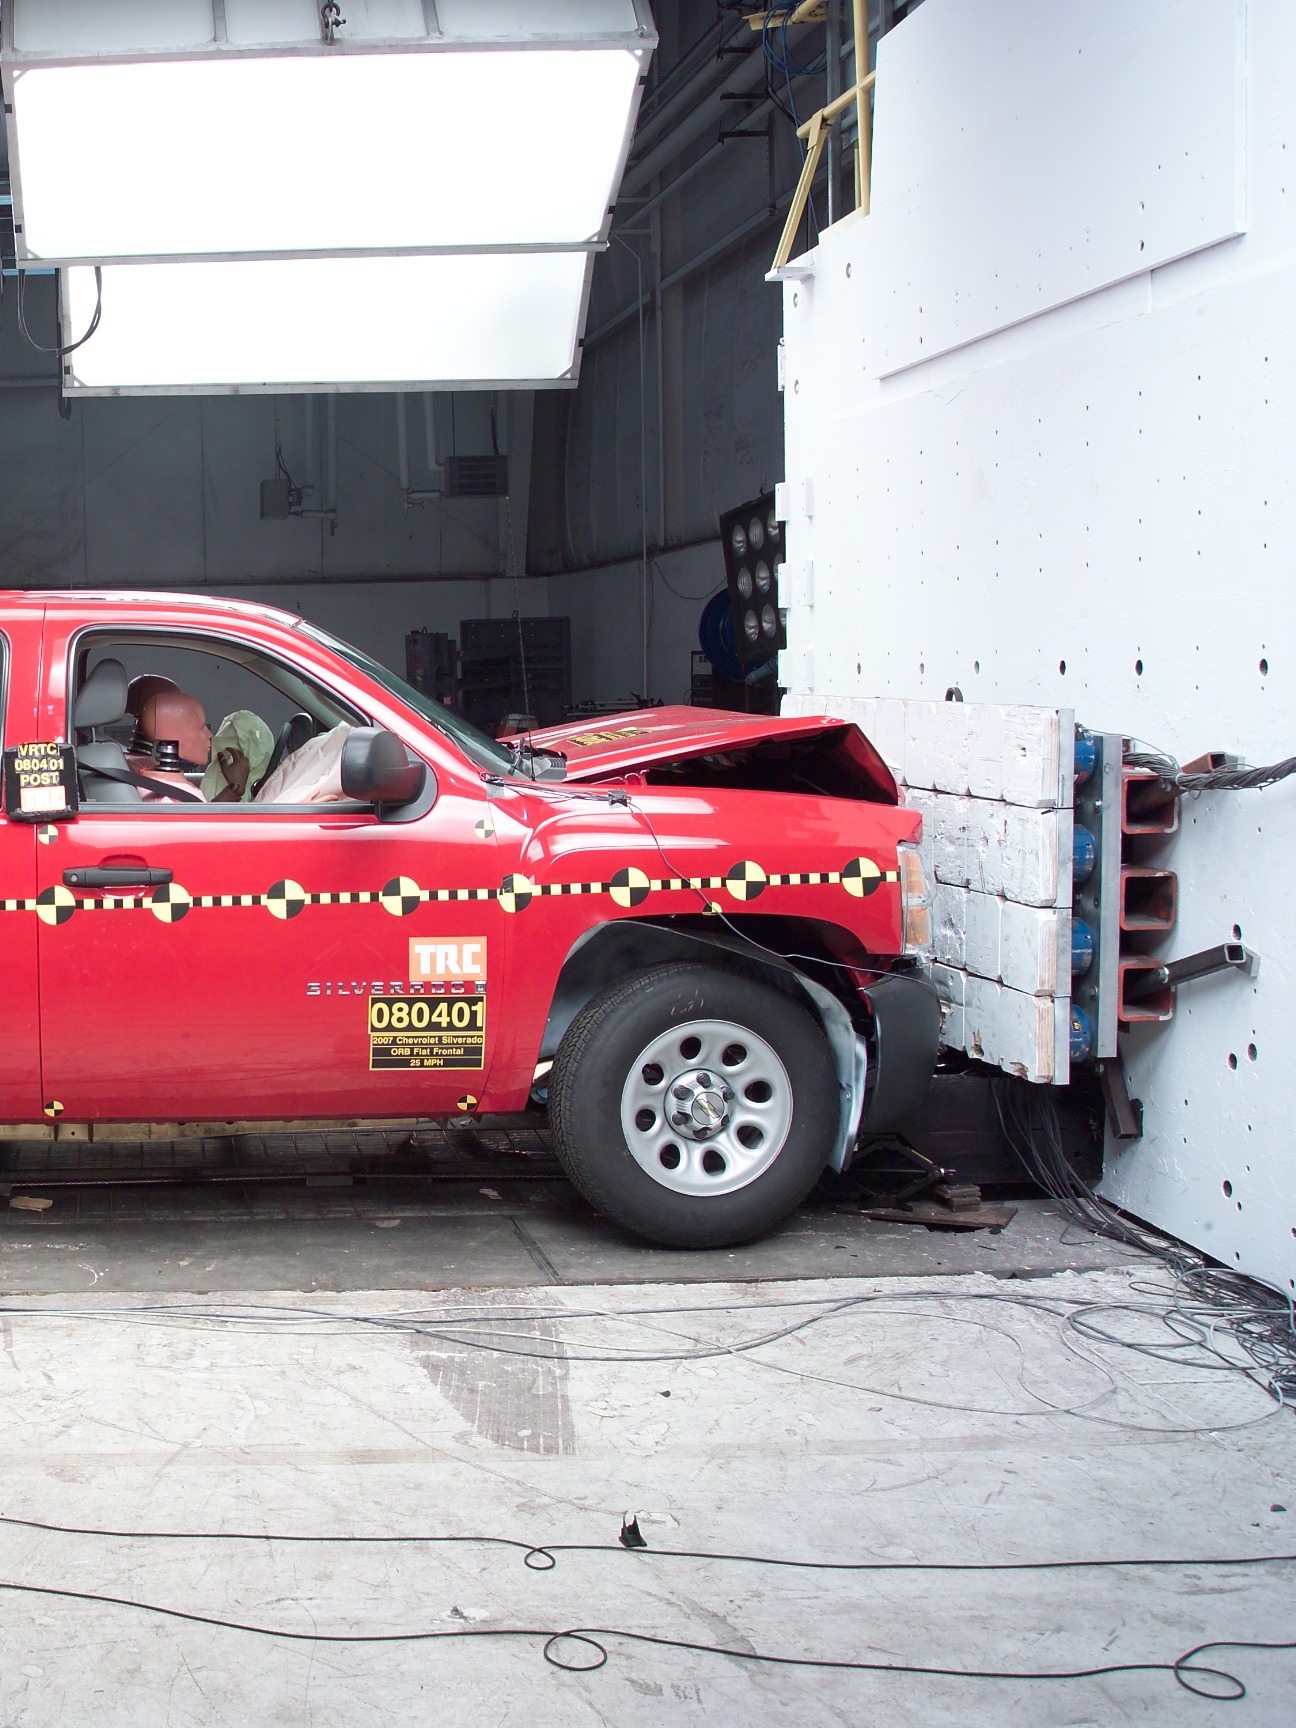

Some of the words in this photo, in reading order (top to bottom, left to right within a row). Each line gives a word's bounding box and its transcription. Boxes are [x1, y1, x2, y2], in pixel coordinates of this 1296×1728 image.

[19, 743, 57, 757] VRTC
[20, 772, 59, 786] POST
[414, 943, 482, 975] TRC
[306, 981, 465, 996] SILVERADO
[371, 1001, 484, 1029] 080401
[372, 1036, 394, 1045] 2007
[396, 1036, 439, 1045] Chevrolet
[442, 1035, 483, 1044] Silverado
[390, 1047, 411, 1056] ORB
[413, 1047, 431, 1056] Flat
[433, 1046, 464, 1055] Frontal
[409, 1058, 421, 1067] 25
[423, 1058, 444, 1067] MPH
